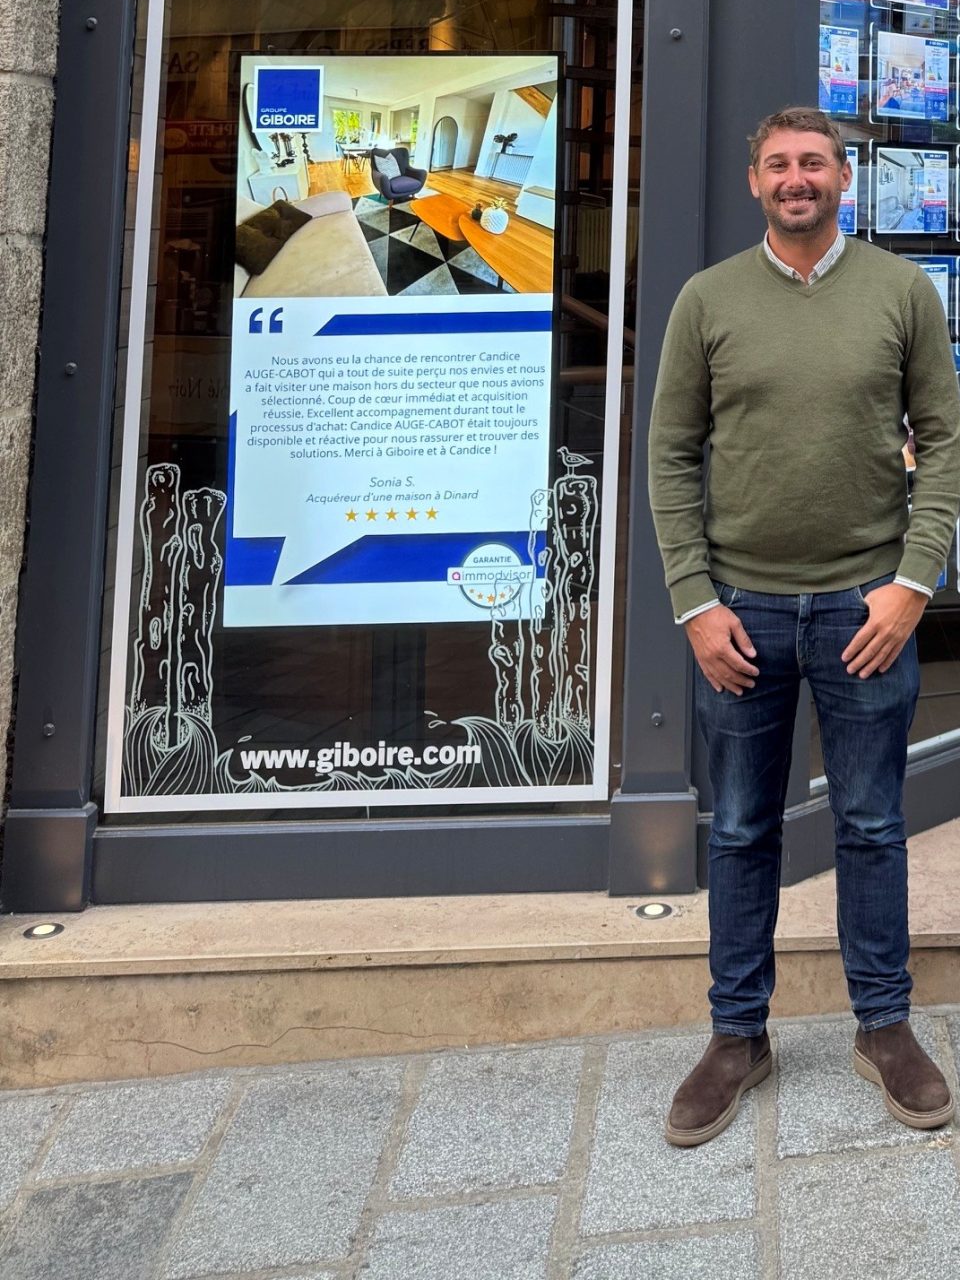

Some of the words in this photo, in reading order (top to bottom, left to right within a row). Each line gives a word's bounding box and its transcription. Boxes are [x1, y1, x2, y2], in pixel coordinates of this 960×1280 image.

[260, 114, 315, 125] GIBOIRE
[271, 355, 298, 365] Nous
[301, 357, 333, 365] avons
[336, 356, 349, 364] eu
[352, 354, 360, 364] la
[364, 353, 401, 363] chance
[404, 353, 417, 363] de
[420, 353, 476, 362] rencontrer
[479, 351, 520, 361] Candice
[244, 368, 316, 379] AUGE-CABOT
[318, 368, 334, 380] qui
[347, 369, 368, 377] tout
[371, 367, 384, 376] de
[387, 366, 413, 376] suite
[416, 367, 446, 378] perçu
[449, 367, 468, 375] nos
[470, 365, 504, 374] envies
[506, 365, 517, 373] et
[520, 365, 545, 373] nous
[245, 384, 251, 392] a
[254, 382, 271, 392] fait
[274, 382, 306, 391] visiter
[309, 383, 329, 391] une
[332, 380, 371, 391] maison
[374, 380, 397, 390] hors
[400, 379, 414, 389] du
[416, 380, 456, 389] secteur
[458, 380, 479, 390] que
[510, 377, 544, 387] avions
[261, 394, 325, 405] sélectionné.
[328, 394, 355, 406] Coup
[358, 393, 371, 403] de
[374, 395, 402, 403] cœur
[405, 391, 455, 403] immédiat
[458, 393, 468, 401] et
[471, 391, 527, 403] acquisition
[263, 408, 304, 419] réussie.
[307, 408, 354, 418] Excellent
[356, 407, 451, 419] accompagnement
[453, 405, 488, 414] durant
[492, 405, 512, 413] tout
[516, 403, 525, 413] le
[250, 424, 303, 435] processus
[306, 421, 347, 431] d'achat:
[350, 421, 392, 430] Candice
[394, 417, 464, 430] AUGE-CABOT
[467, 418, 490, 428] était
[494, 417, 537, 429] toujours
[247, 436, 302, 447] disponible
[305, 436, 315, 445] et
[318, 434, 360, 444] réactive
[362, 436, 388, 446] pour
[391, 435, 417, 443] nous
[420, 434, 464, 442] rassurer
[466, 433, 476, 441] et
[479, 432, 518, 441] trouver
[520, 430, 538, 440] des
[290, 448, 341, 458] solutions.
[344, 448, 373, 457] Merci
[376, 447, 382, 456] à
[385, 446, 424, 456] Giboire
[426, 447, 436, 455] et
[440, 445, 446, 455] à
[449, 444, 491, 455] Candice
[369, 476, 401, 487] Sonia
[405, 475, 416, 487] S.
[305, 492, 360, 505] Acquéreur
[362, 491, 392, 501] d’une
[394, 491, 431, 501] maison
[434, 490, 440, 500] à
[443, 489, 478, 500] Dinard
[462, 570, 532, 581] immodvisor
[240, 741, 481, 772] www.giboire.com
